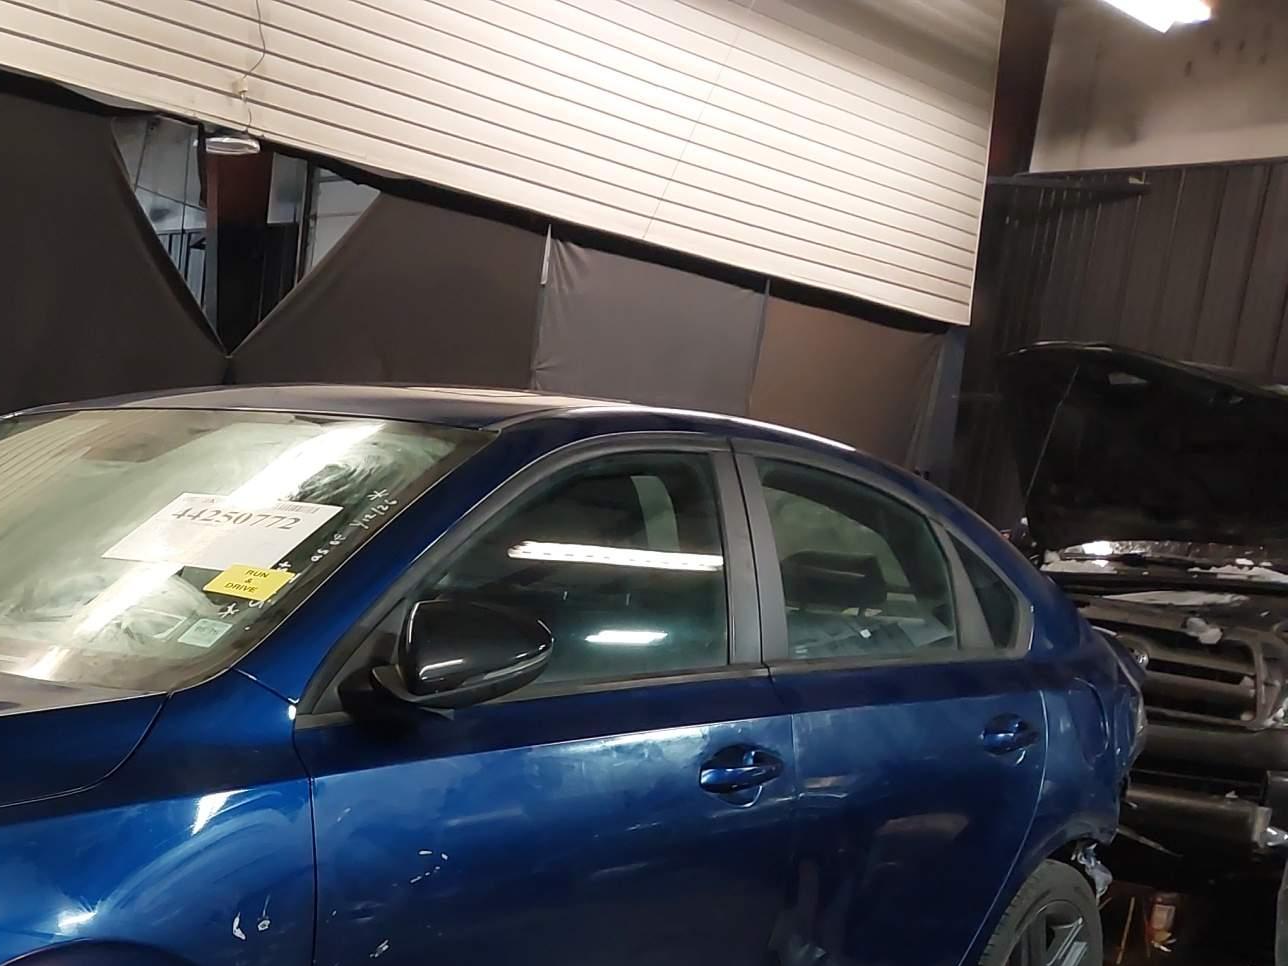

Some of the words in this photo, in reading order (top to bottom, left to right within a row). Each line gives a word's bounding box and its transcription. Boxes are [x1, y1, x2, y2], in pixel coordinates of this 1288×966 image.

[171, 507, 301, 531] 44250772
[245, 569, 270, 579] RUN
[224, 582, 259, 594] DRIVE
